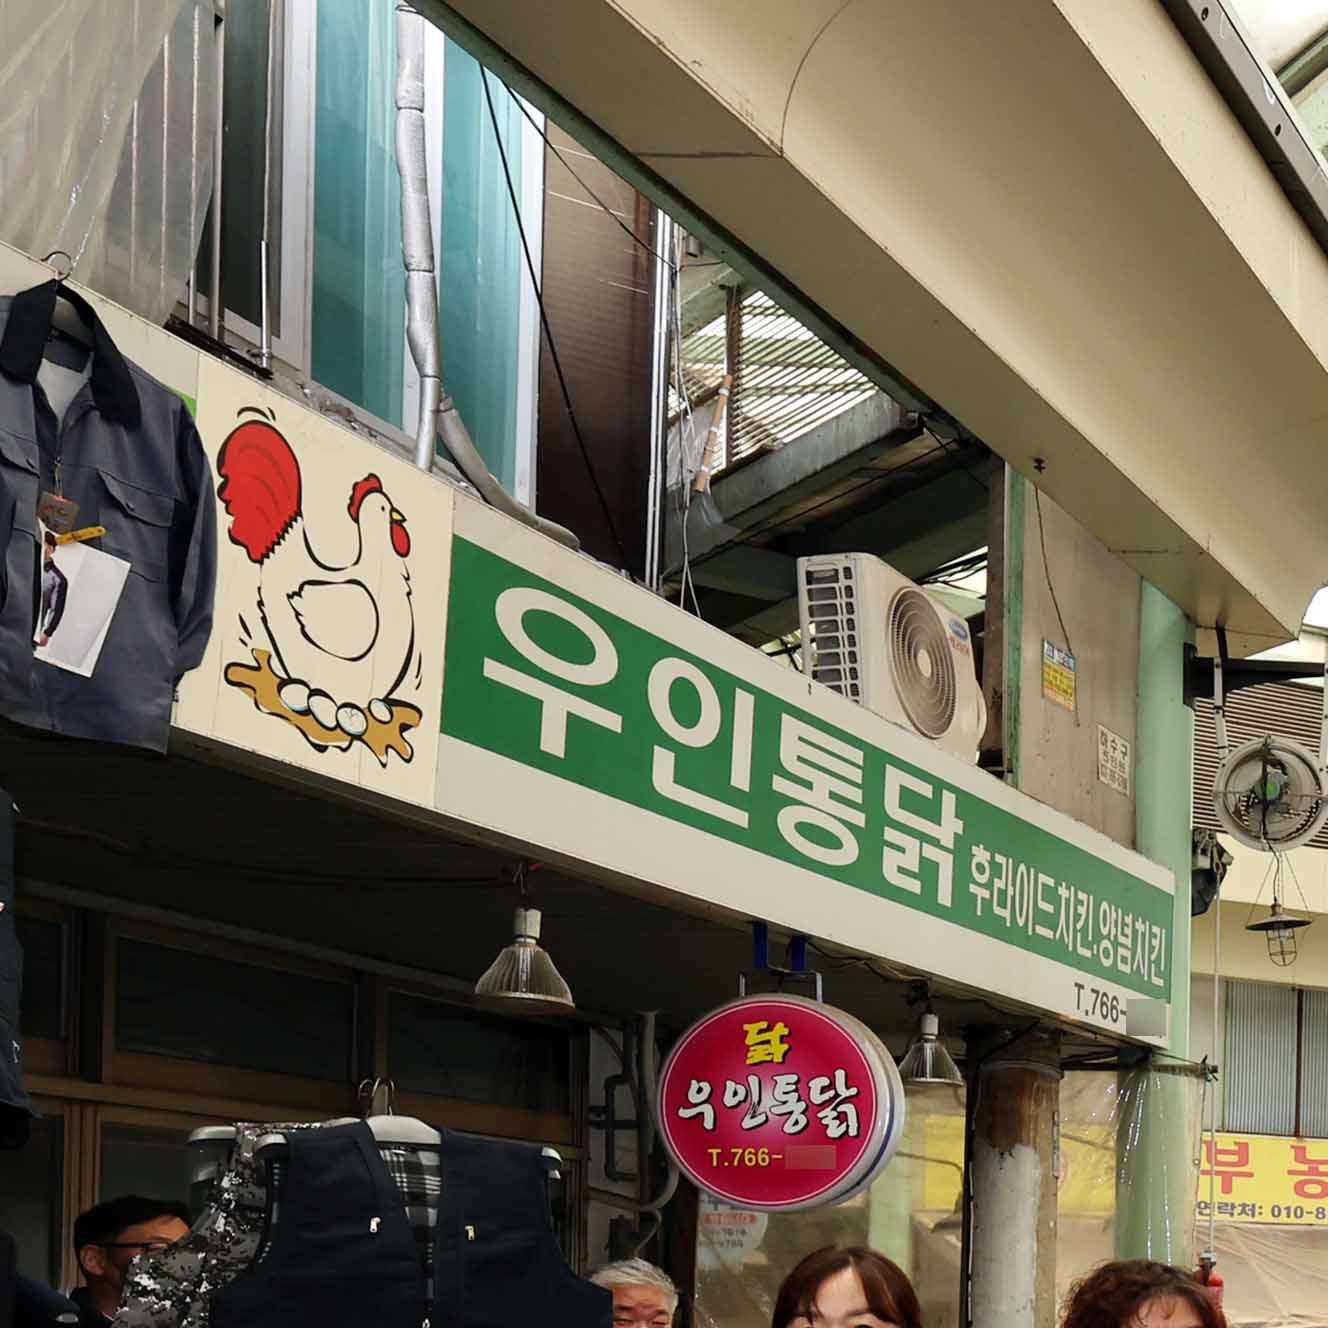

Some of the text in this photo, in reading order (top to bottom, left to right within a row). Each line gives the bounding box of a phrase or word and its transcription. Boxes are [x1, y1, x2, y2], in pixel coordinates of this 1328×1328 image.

[483, 586, 964, 907] 우인통닭
[743, 1021, 789, 1065] 닭
[678, 1069, 860, 1138] 우인통닭
